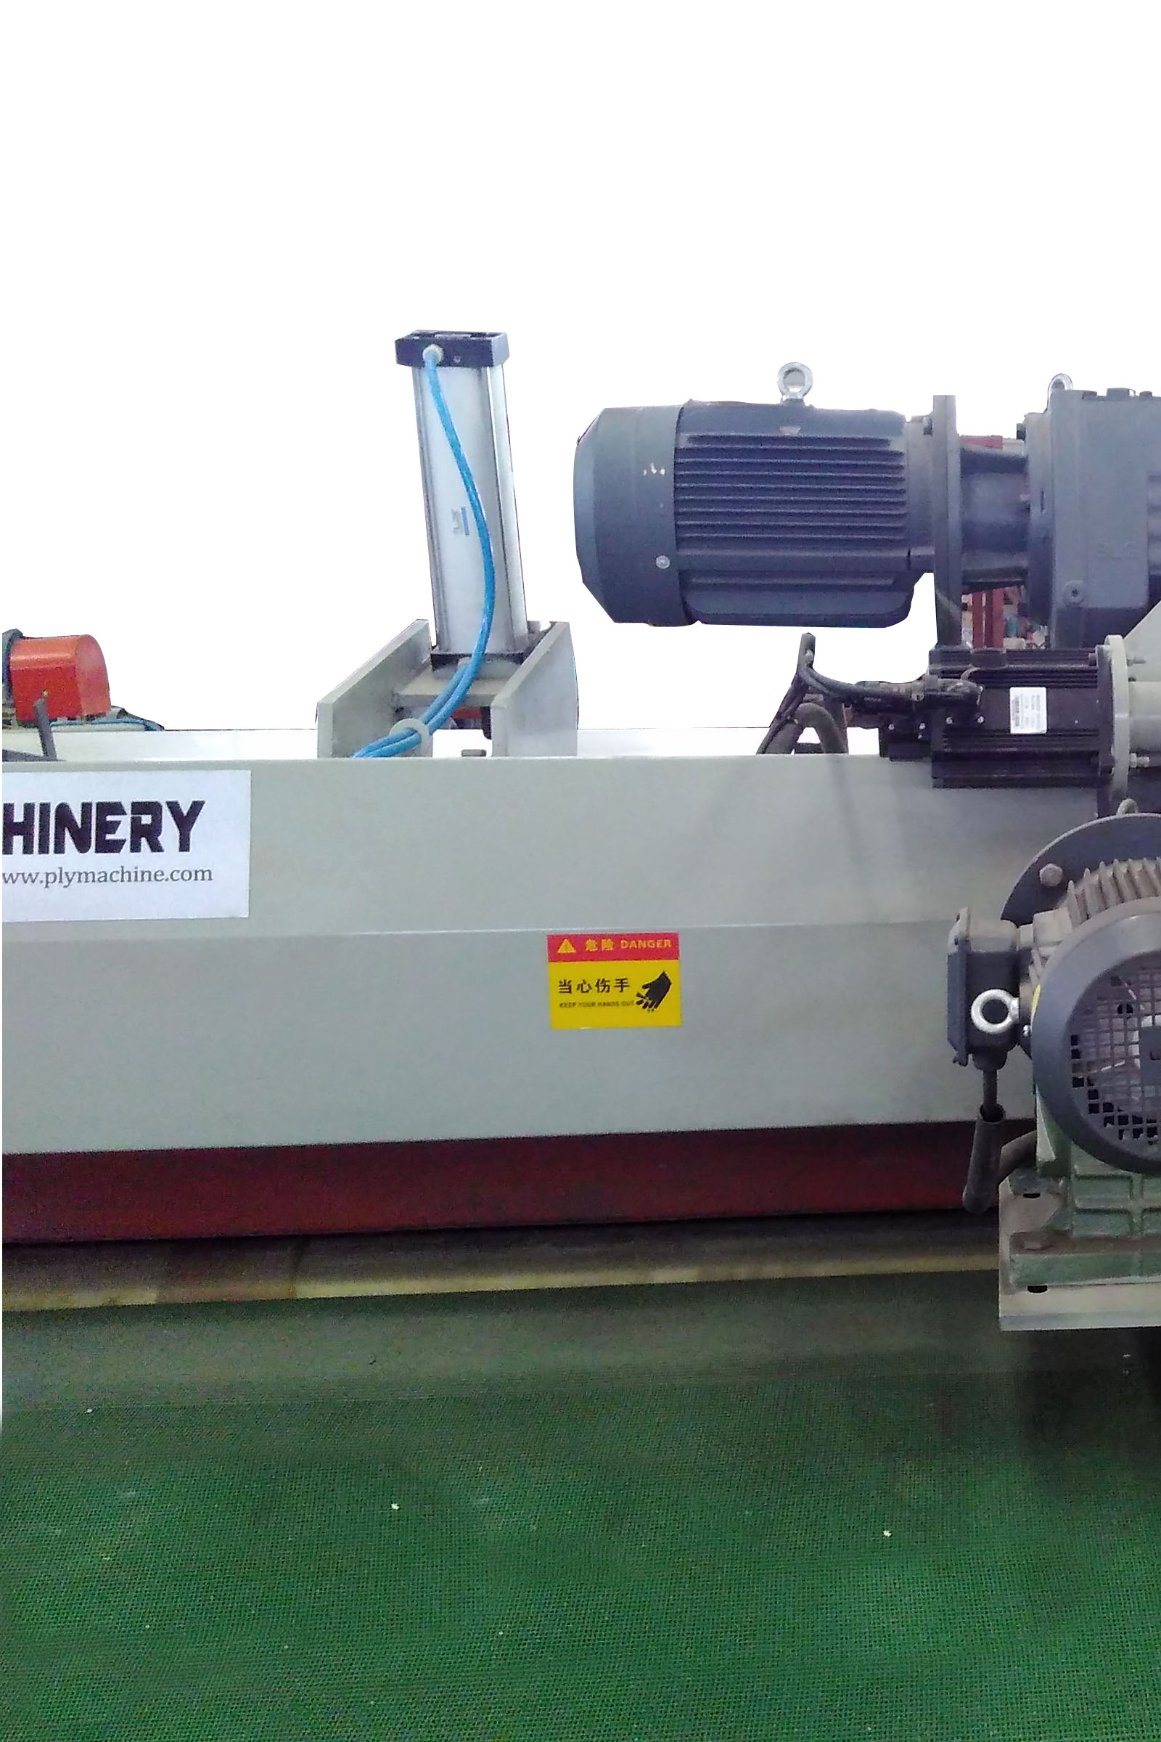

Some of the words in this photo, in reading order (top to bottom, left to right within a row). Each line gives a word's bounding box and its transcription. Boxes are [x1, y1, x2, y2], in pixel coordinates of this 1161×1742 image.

[2, 800, 206, 855] HINERY
[620, 939, 672, 949] DANGER
[558, 978, 630, 994] 当心伤手
